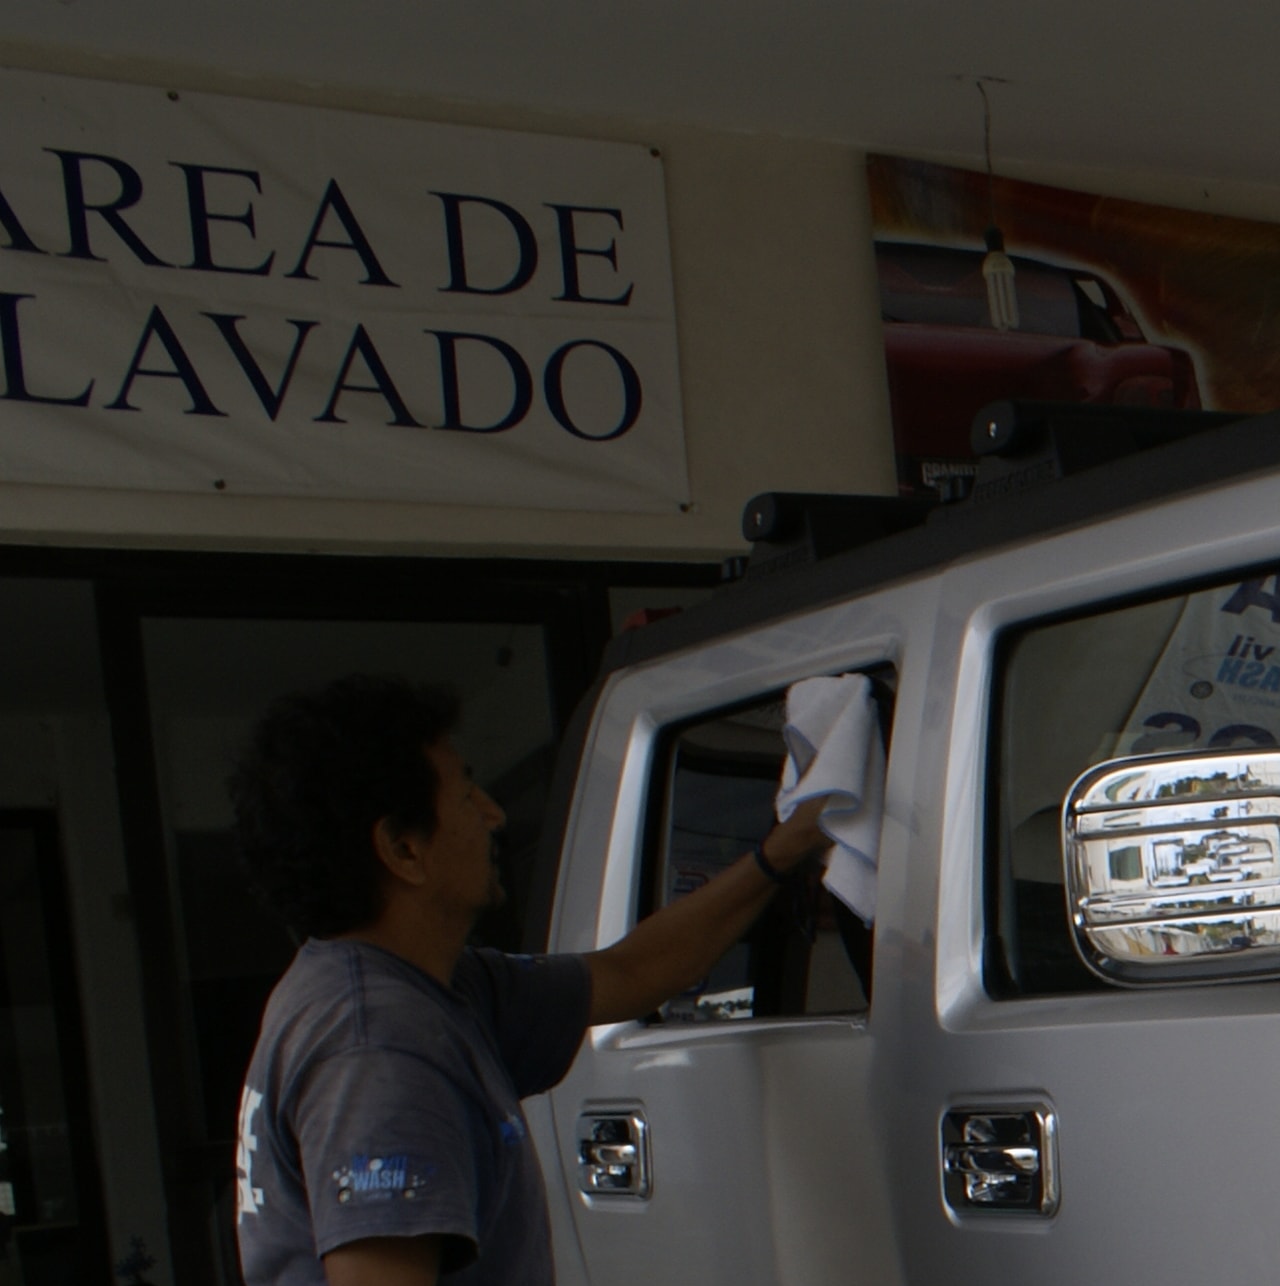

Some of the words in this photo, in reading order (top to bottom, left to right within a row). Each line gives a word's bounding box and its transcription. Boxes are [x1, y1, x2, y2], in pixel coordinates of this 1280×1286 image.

[427, 190, 635, 307] DE
[0, 293, 643, 442] LAVADO
[352, 1169, 405, 1192] WASH
